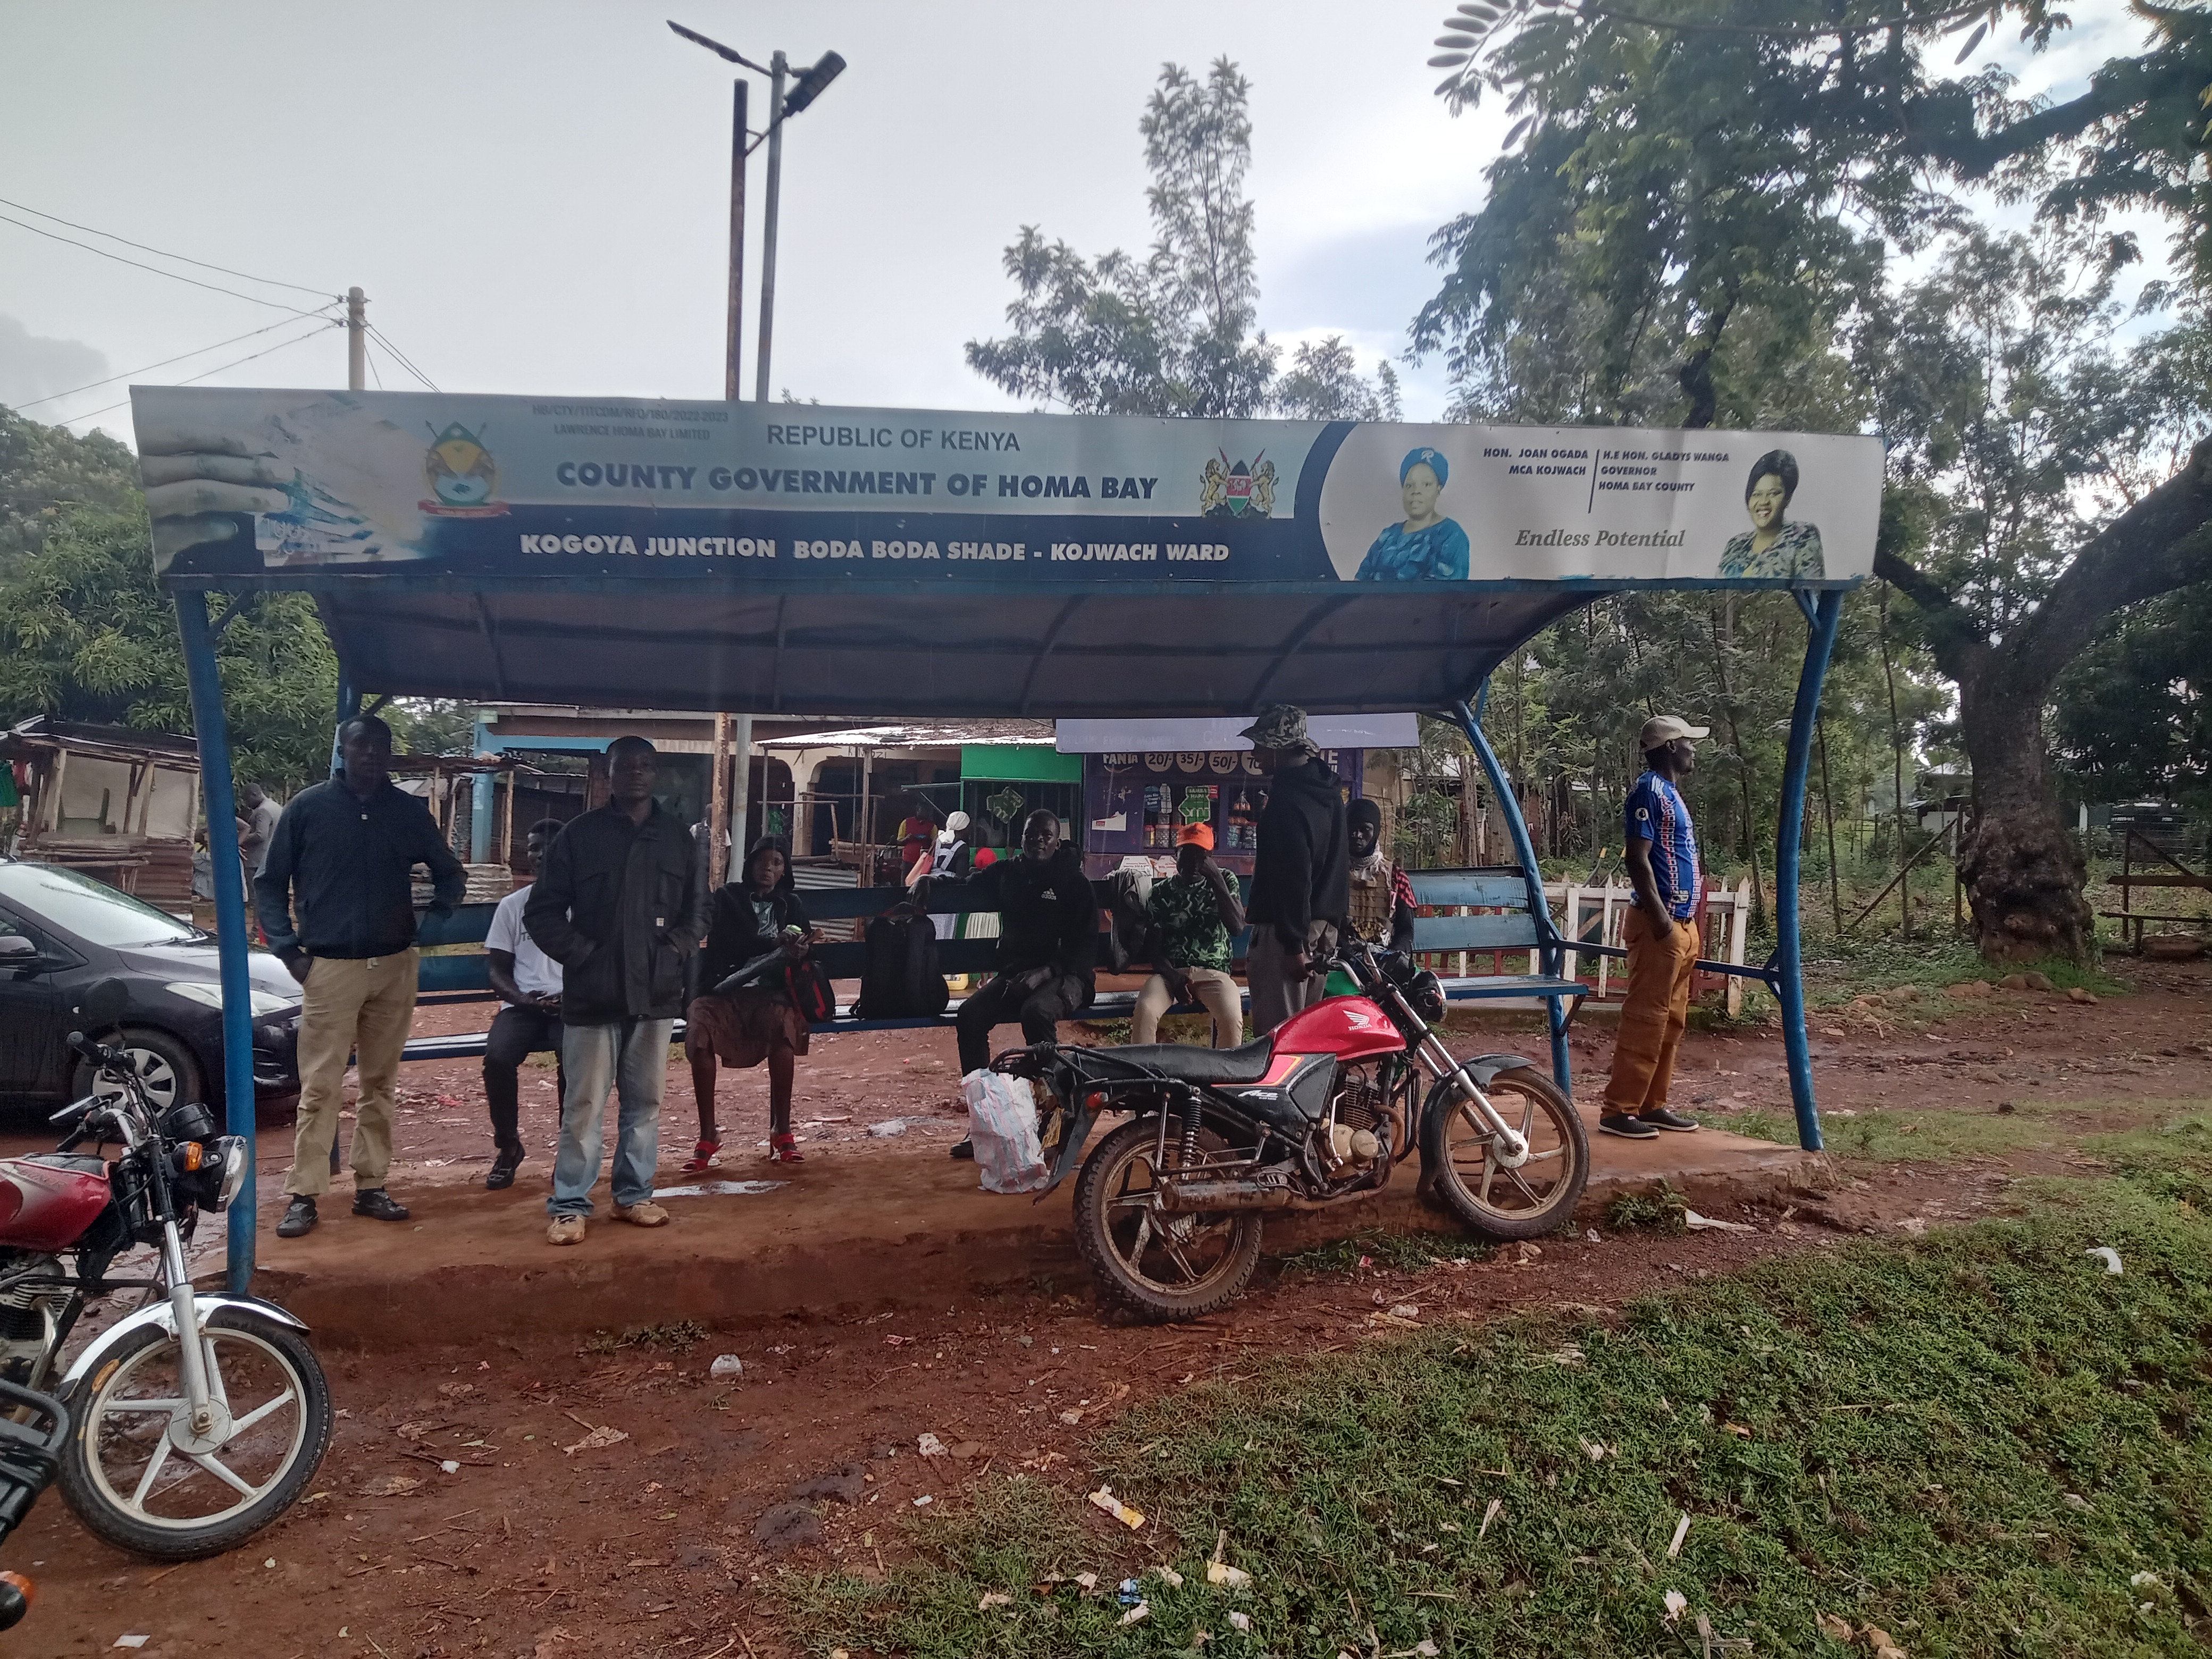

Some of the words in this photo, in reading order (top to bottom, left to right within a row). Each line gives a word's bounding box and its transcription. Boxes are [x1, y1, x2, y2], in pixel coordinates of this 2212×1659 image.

[554, 423, 609, 436] LAWRENCE
[613, 425, 644, 437] HOMA
[647, 428, 667, 438] BAY
[669, 428, 710, 441] LIMITED
[767, 424, 893, 448] REPUBLIC
[900, 428, 933, 449] OF
[941, 430, 1021, 452] KENYA
[1483, 448, 1512, 459] HON.
[1518, 449, 1548, 459] JOAN
[1551, 449, 1589, 460] OGADA
[1622, 451, 1648, 460] HON.
[1651, 451, 1691, 462] GLADYS
[1694, 453, 1730, 462] WANGA
[1508, 465, 1534, 475] MCA
[1536, 465, 1587, 476] KOJWACH
[1600, 466, 1657, 476] GOVERNOR
[557, 462, 696, 490] COUNTY
[709, 467, 936, 495] GOVERNMENT
[947, 473, 987, 497] OF
[998, 474, 1091, 499] HOMA
[1101, 477, 1159, 500] BAY
[1597, 481, 1629, 491] HOMA
[1632, 481, 1653, 491] BAY
[1655, 482, 1695, 492] COUNTY
[1514, 530, 1590, 547] Endless
[1594, 530, 1685, 548] Potential
[520, 534, 638, 556] KOGOYA
[643, 537, 776, 558] JUNCTION
[793, 540, 865, 559] BODA
[872, 541, 941, 560] BODA
[946, 542, 1026, 561] SHADE
[1051, 543, 1157, 563] KOJWACH
[1166, 543, 1230, 563] WARD
[1102, 752, 1138, 765] FANTA
[1148, 753, 1173, 766] 20/-
[1180, 753, 1203, 766] 35/-
[1212, 756, 1236, 770] 50/-
